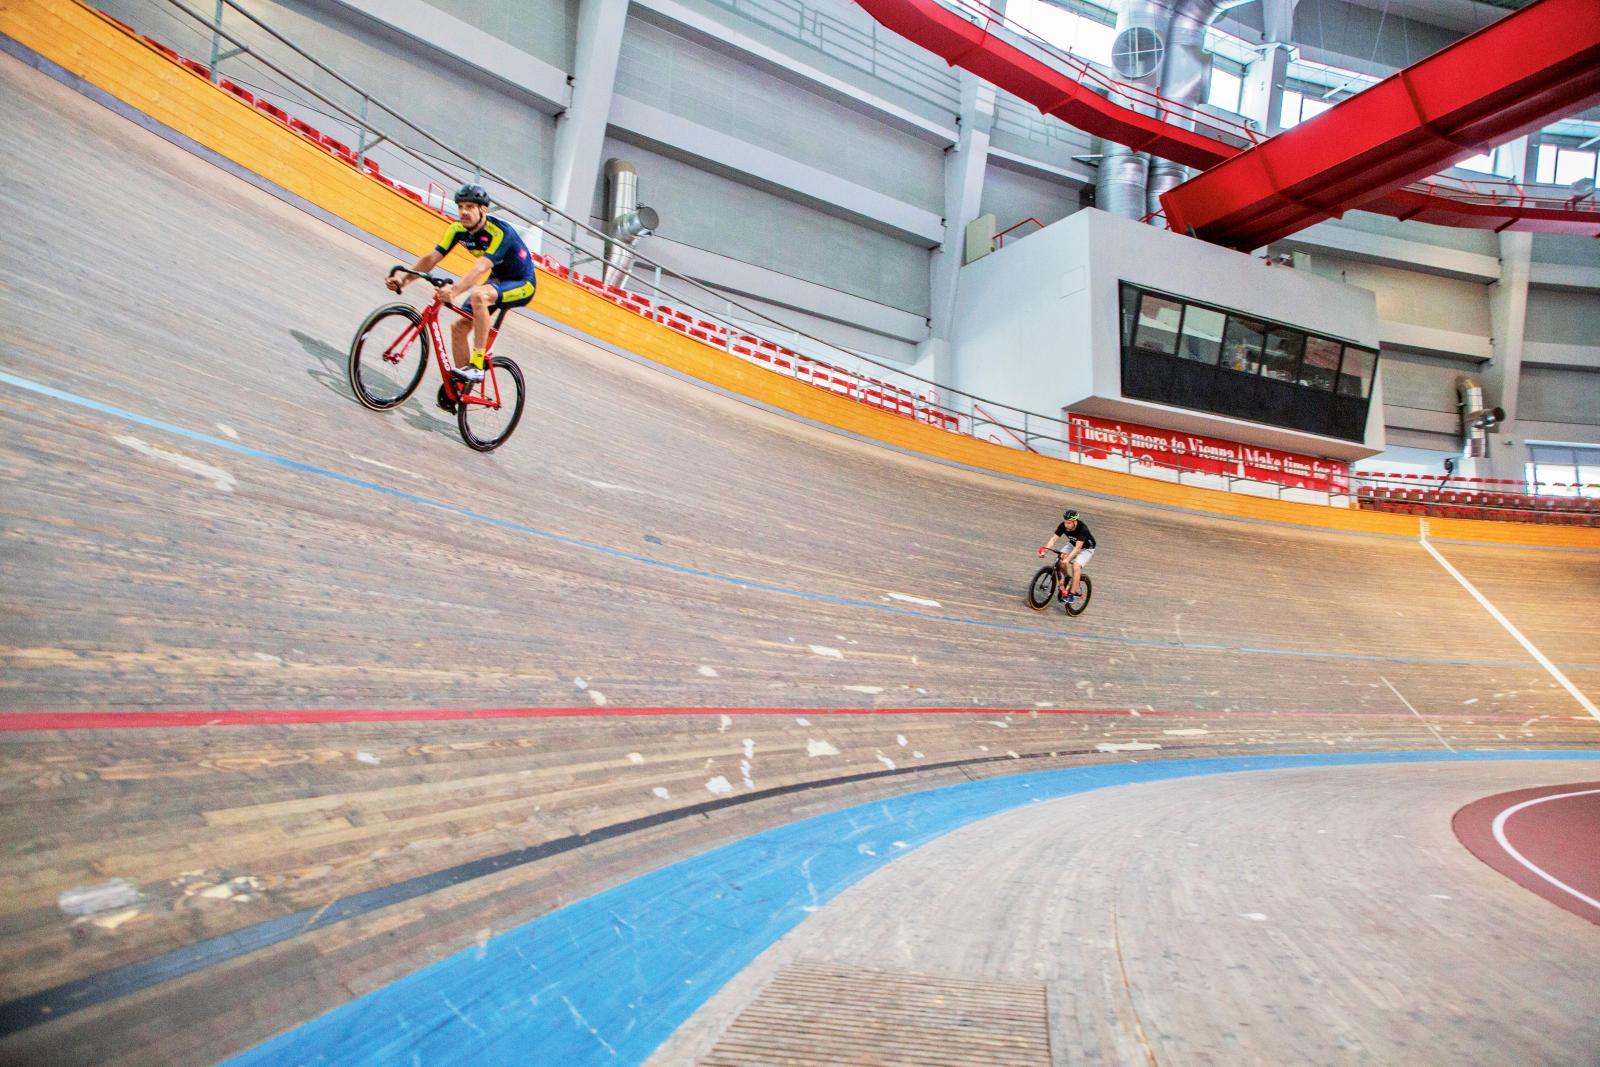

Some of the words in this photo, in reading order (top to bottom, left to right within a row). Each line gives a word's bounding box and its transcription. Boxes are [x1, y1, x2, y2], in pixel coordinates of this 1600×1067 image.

[1072, 418, 1128, 446] There's
[1131, 433, 1168, 452] more
[1171, 436, 1186, 455] to
[1188, 437, 1238, 462] Vienna
[1245, 447, 1282, 472] Make
[1283, 456, 1311, 477] time
[1313, 461, 1331, 480] for
